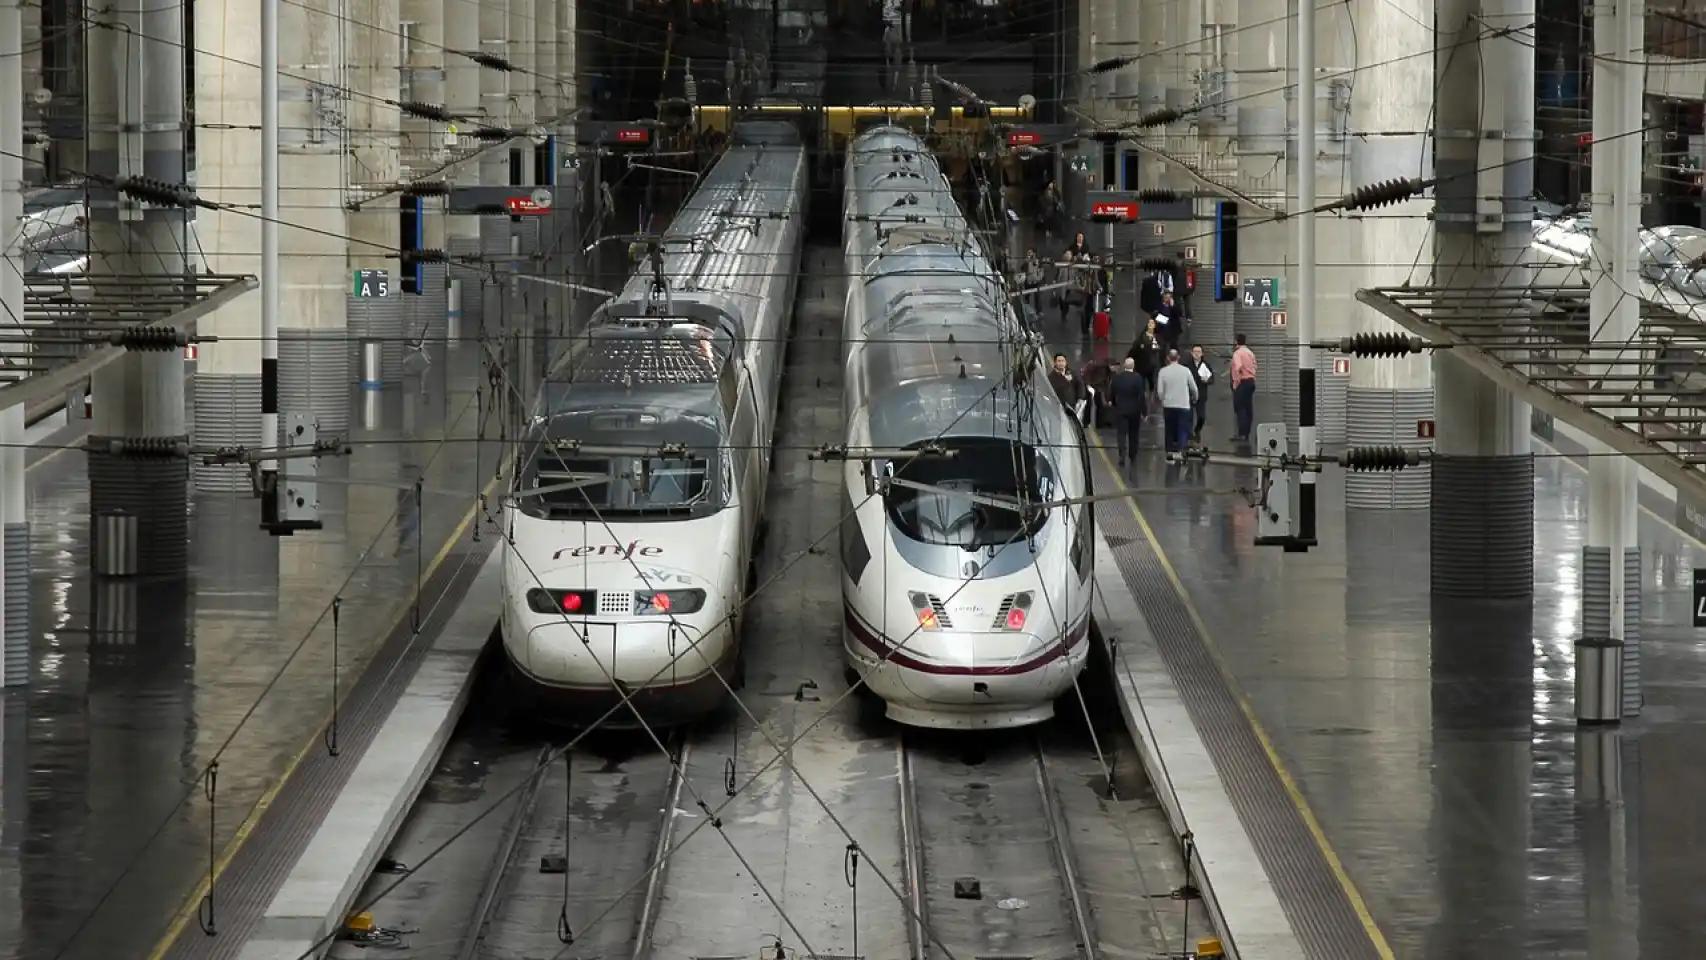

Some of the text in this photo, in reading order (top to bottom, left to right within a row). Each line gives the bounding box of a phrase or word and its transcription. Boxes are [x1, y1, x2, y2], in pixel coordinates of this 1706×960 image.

[361, 282, 388, 297] A 5
[1244, 291, 1271, 306] 4 A
[552, 539, 664, 560] renfe
[635, 567, 693, 585] AVE
